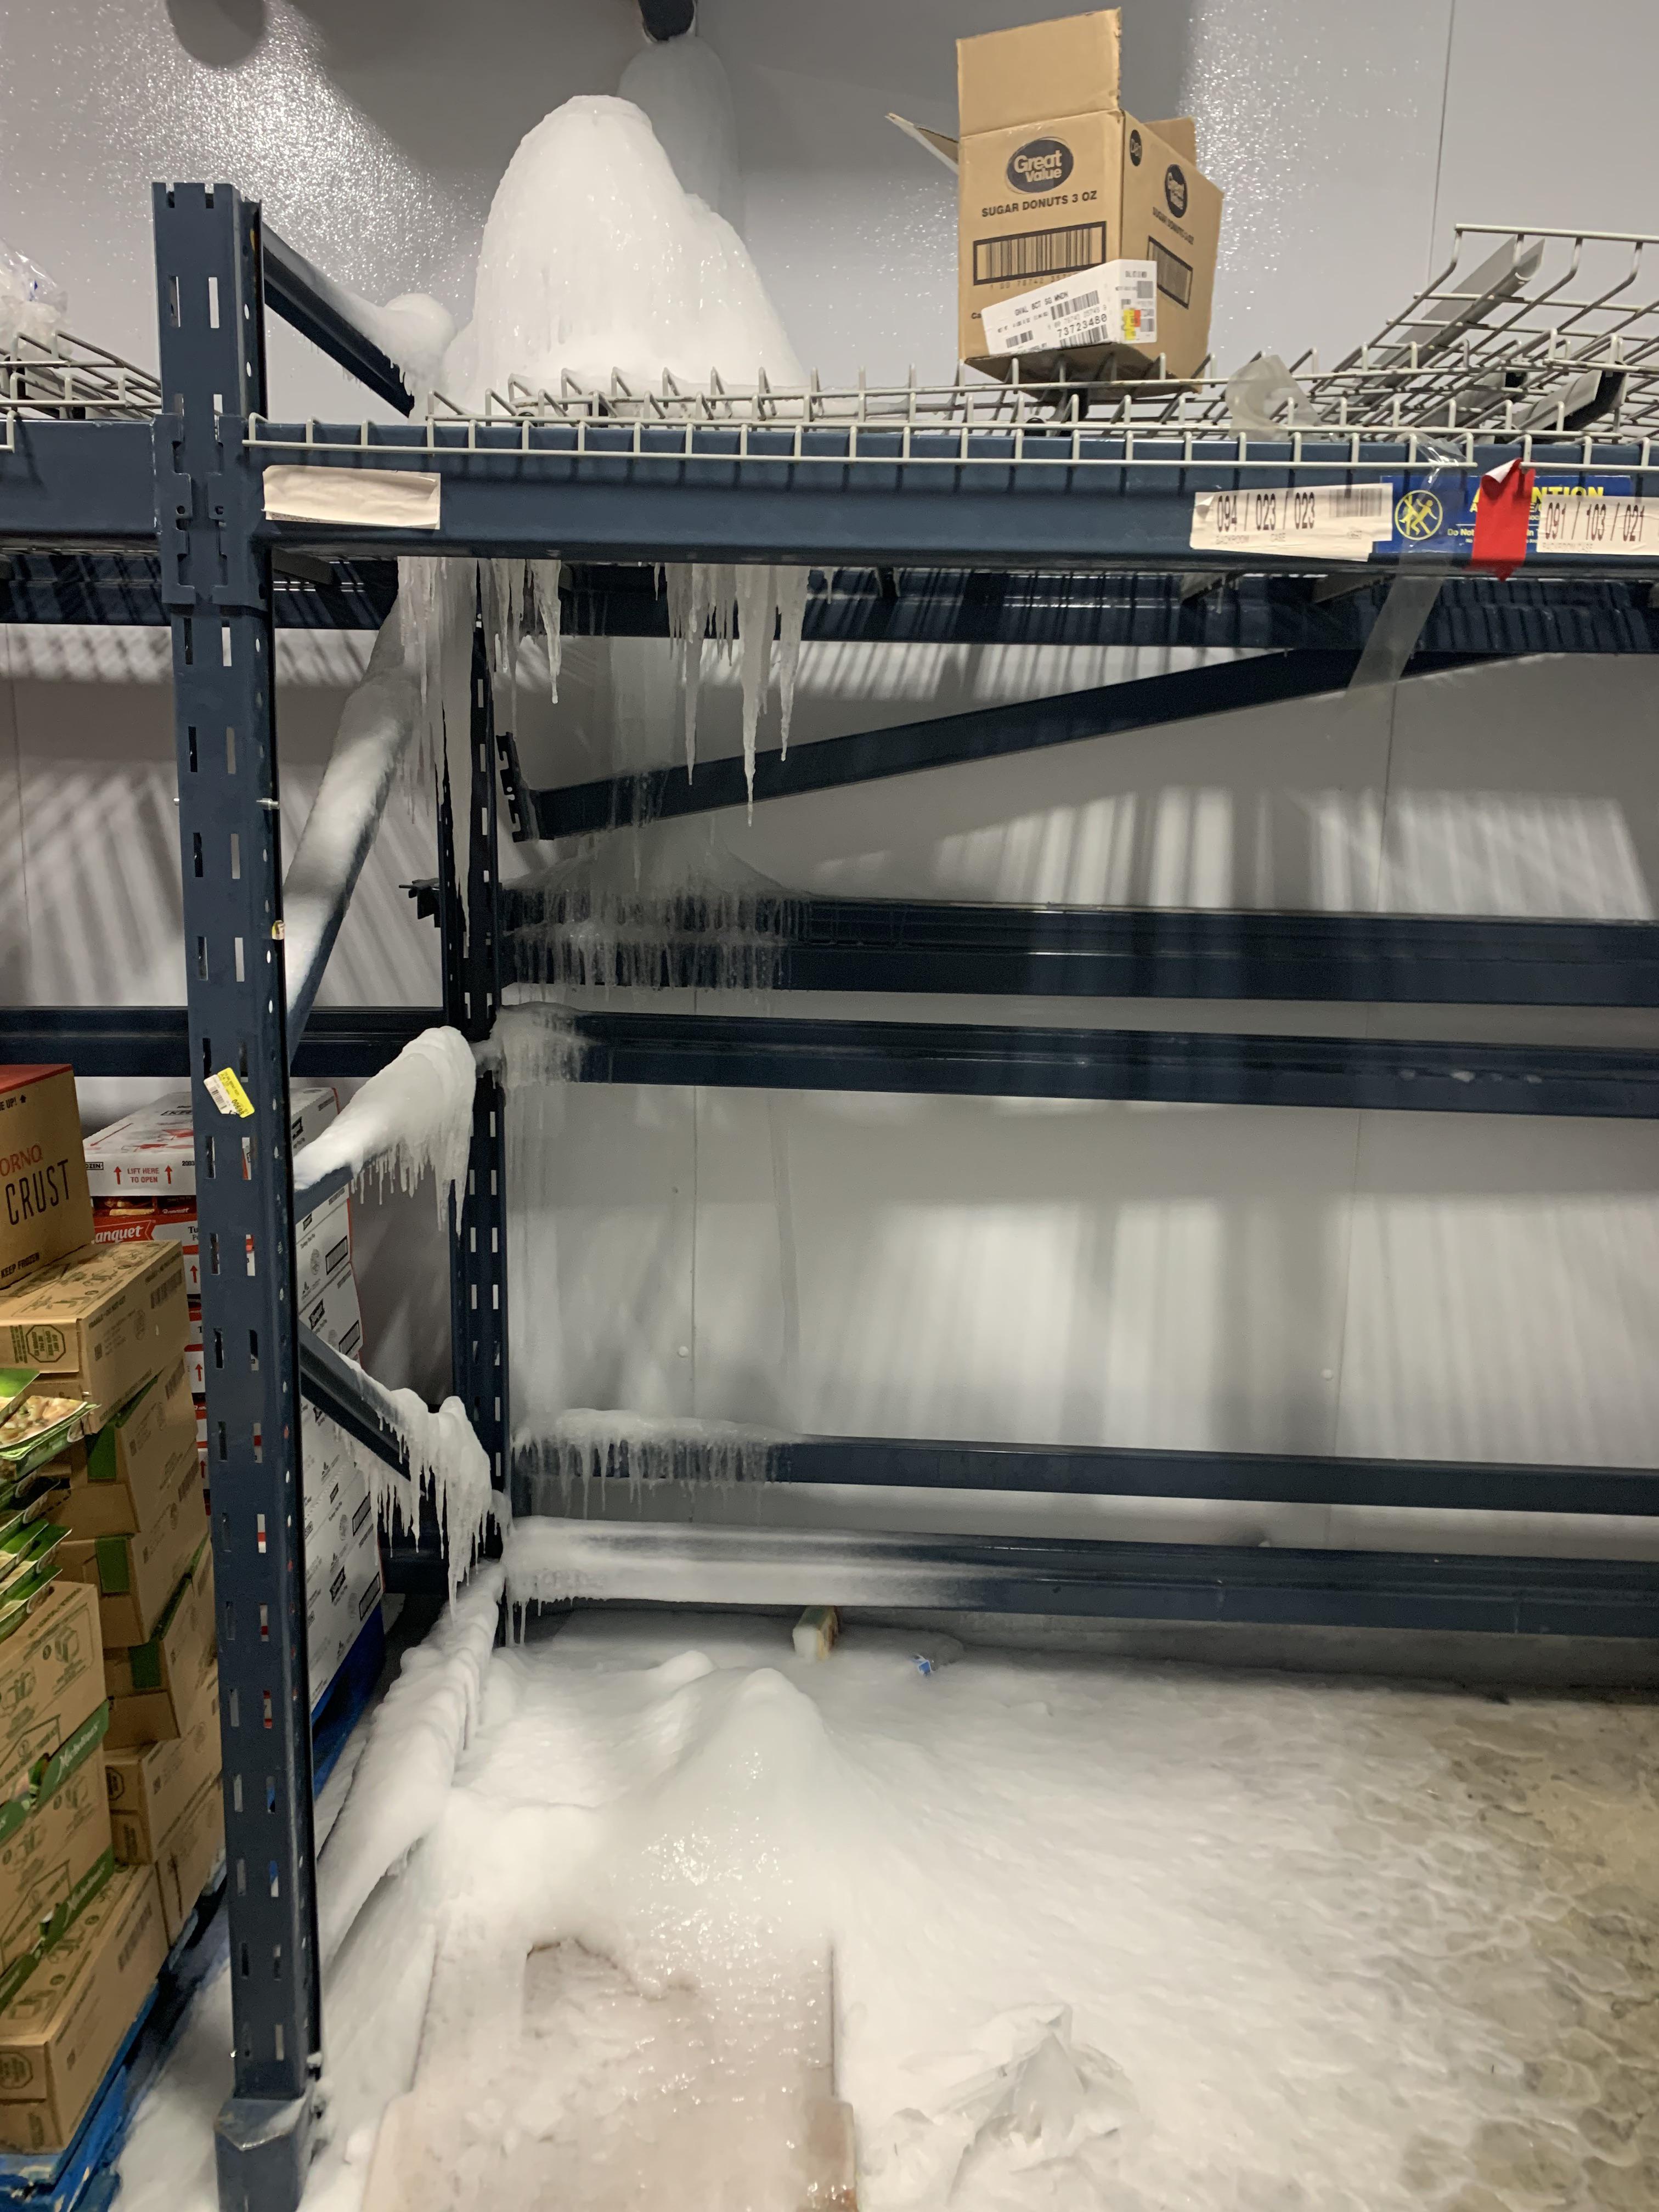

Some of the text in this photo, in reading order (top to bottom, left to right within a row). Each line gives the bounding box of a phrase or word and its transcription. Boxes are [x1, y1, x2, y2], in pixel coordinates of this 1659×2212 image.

[1014, 150, 1063, 173] Great
[1025, 168, 1063, 183] Value
[981, 190, 1097, 217] SUGAR DONUTS 3 OZ
[1057, 313, 1107, 338] 73723480
[1217, 495, 1237, 533] 094
[1255, 493, 1277, 531] 023
[1294, 492, 1315, 530] 023
[1545, 502, 1567, 540] 091
[1586, 503, 1606, 541] 103
[1622, 504, 1646, 542] 021
[5, 1096, 18, 1109] UP!
[0, 1144, 42, 1177] ORNO
[5, 1159, 69, 1226] CRUST
[95, 1225, 144, 1244] anquet
[1, 1252, 40, 1278] KEEP FROZEN
